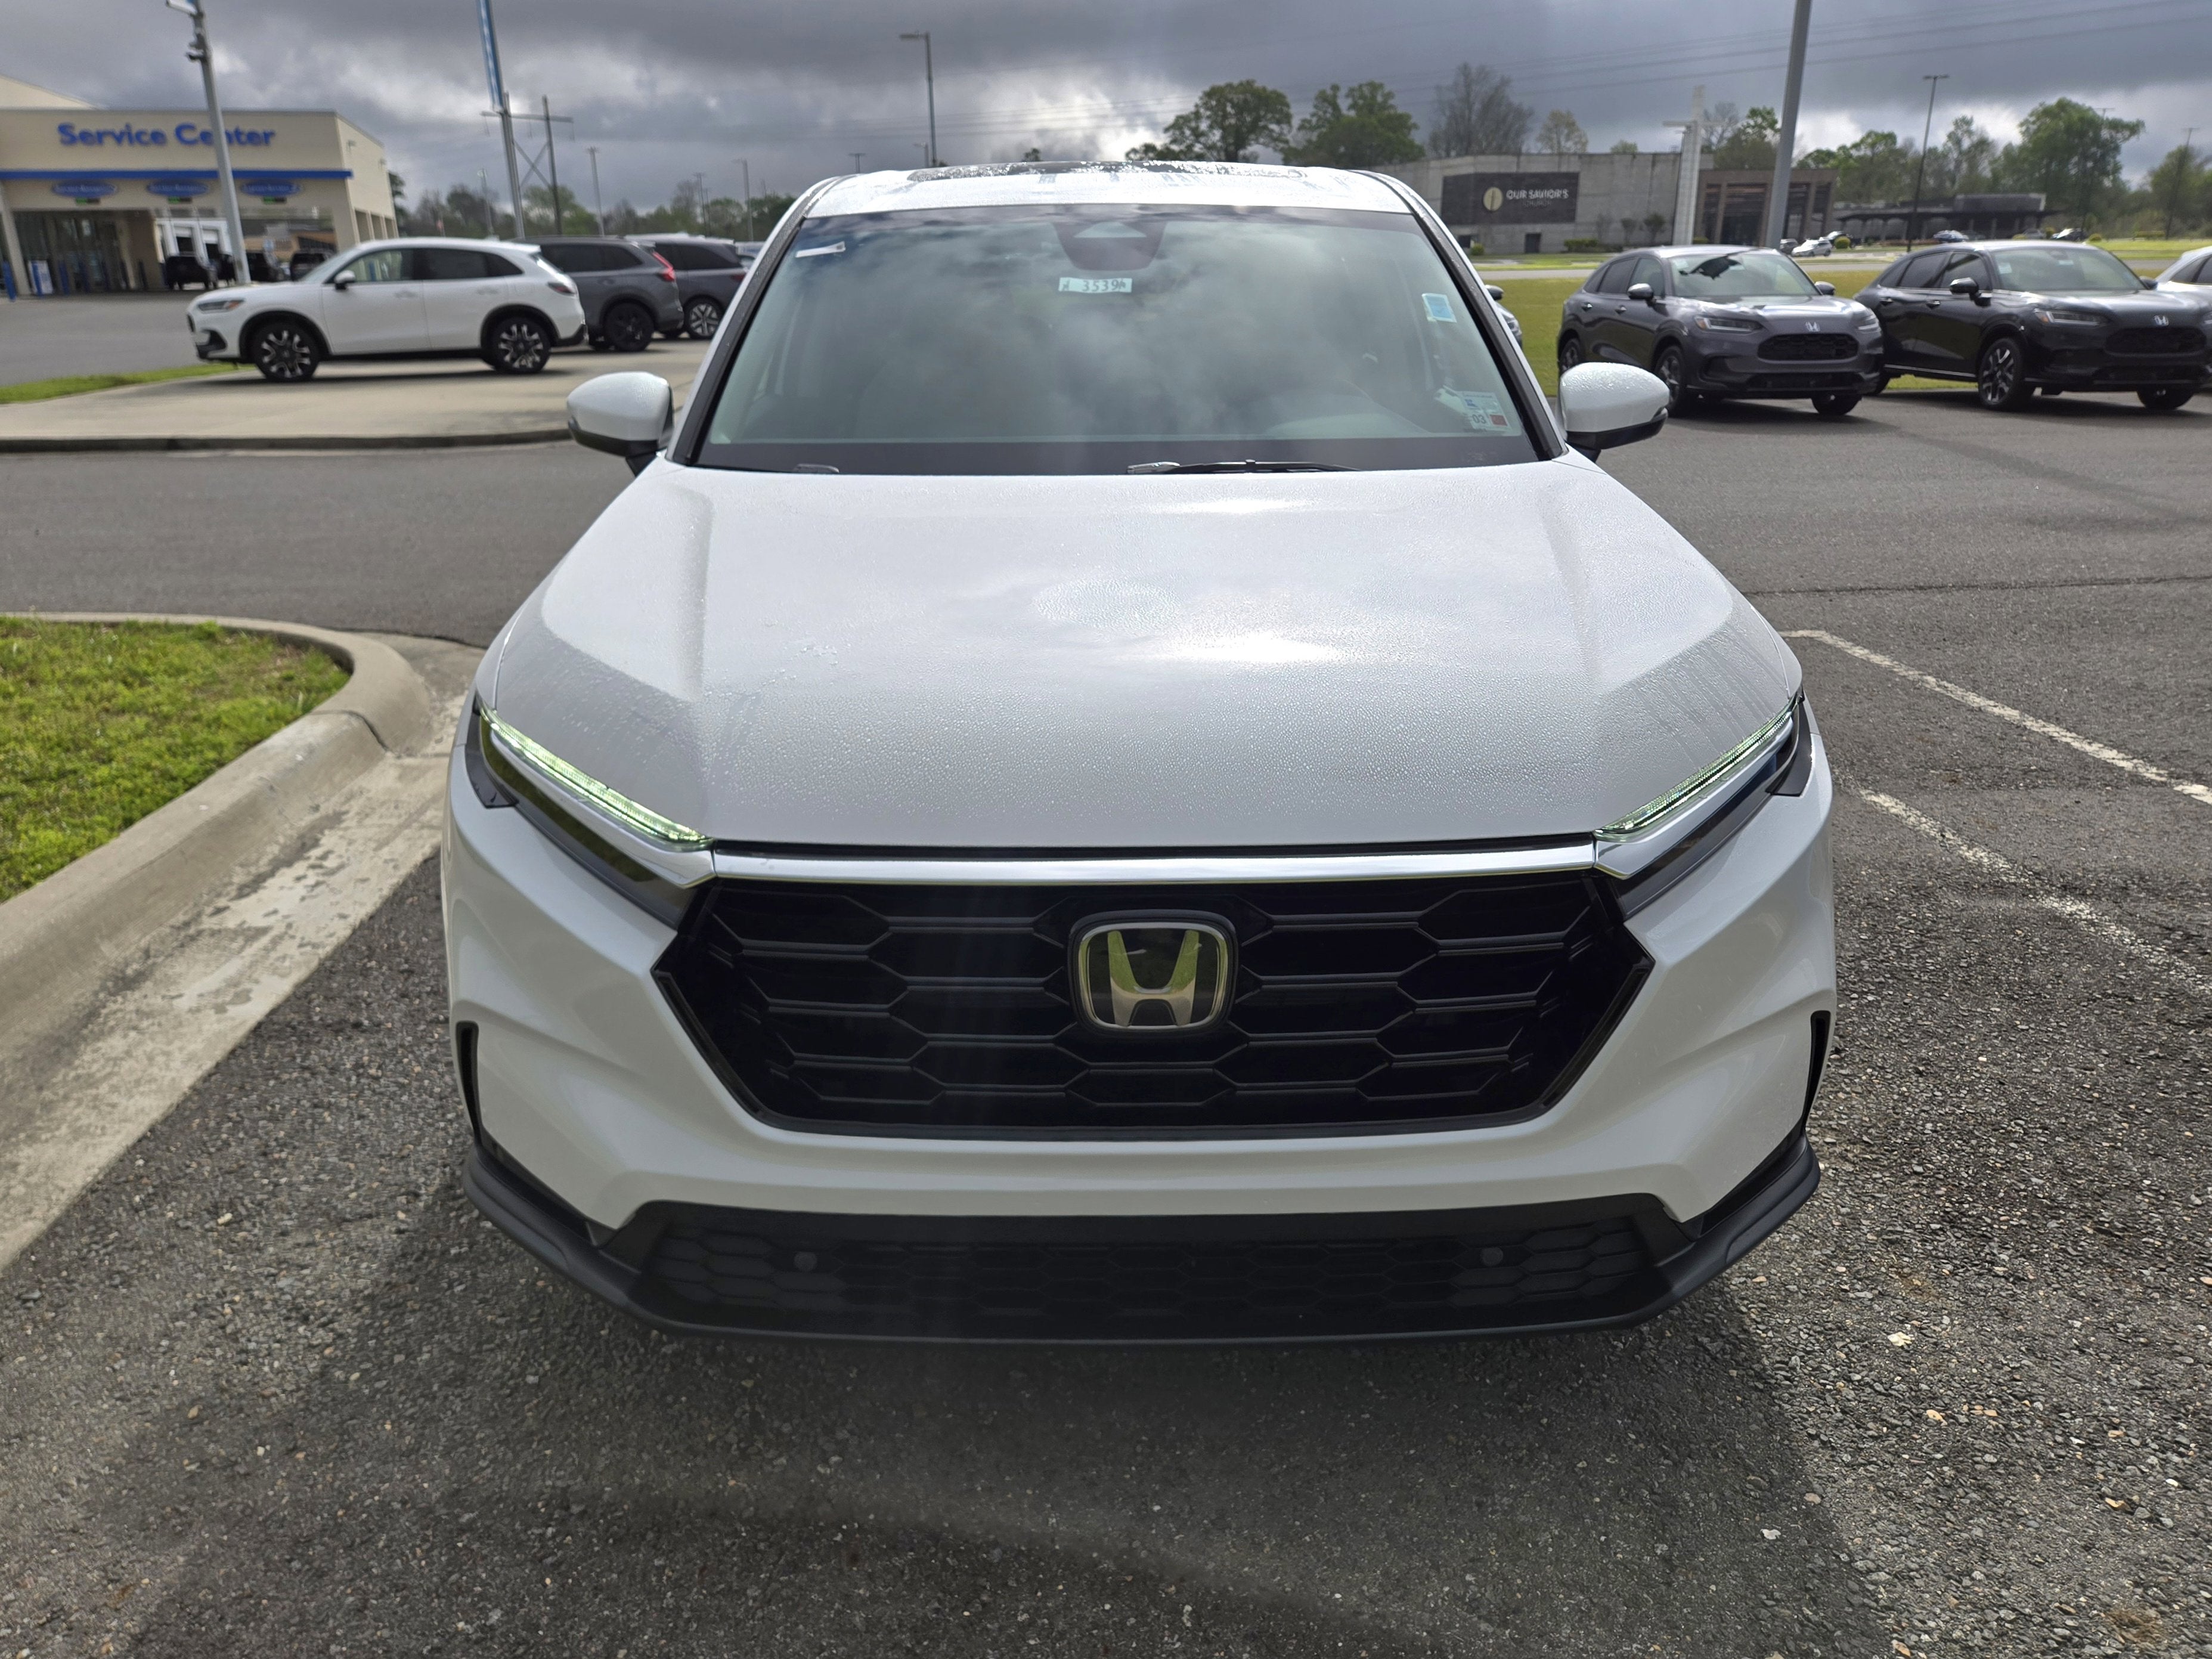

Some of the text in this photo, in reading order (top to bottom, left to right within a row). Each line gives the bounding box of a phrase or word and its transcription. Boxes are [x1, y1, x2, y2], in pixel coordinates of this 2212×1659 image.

[58, 122, 275, 146] Service Center
[1506, 190, 1527, 200] OUR
[1471, 414, 1487, 425] 03
